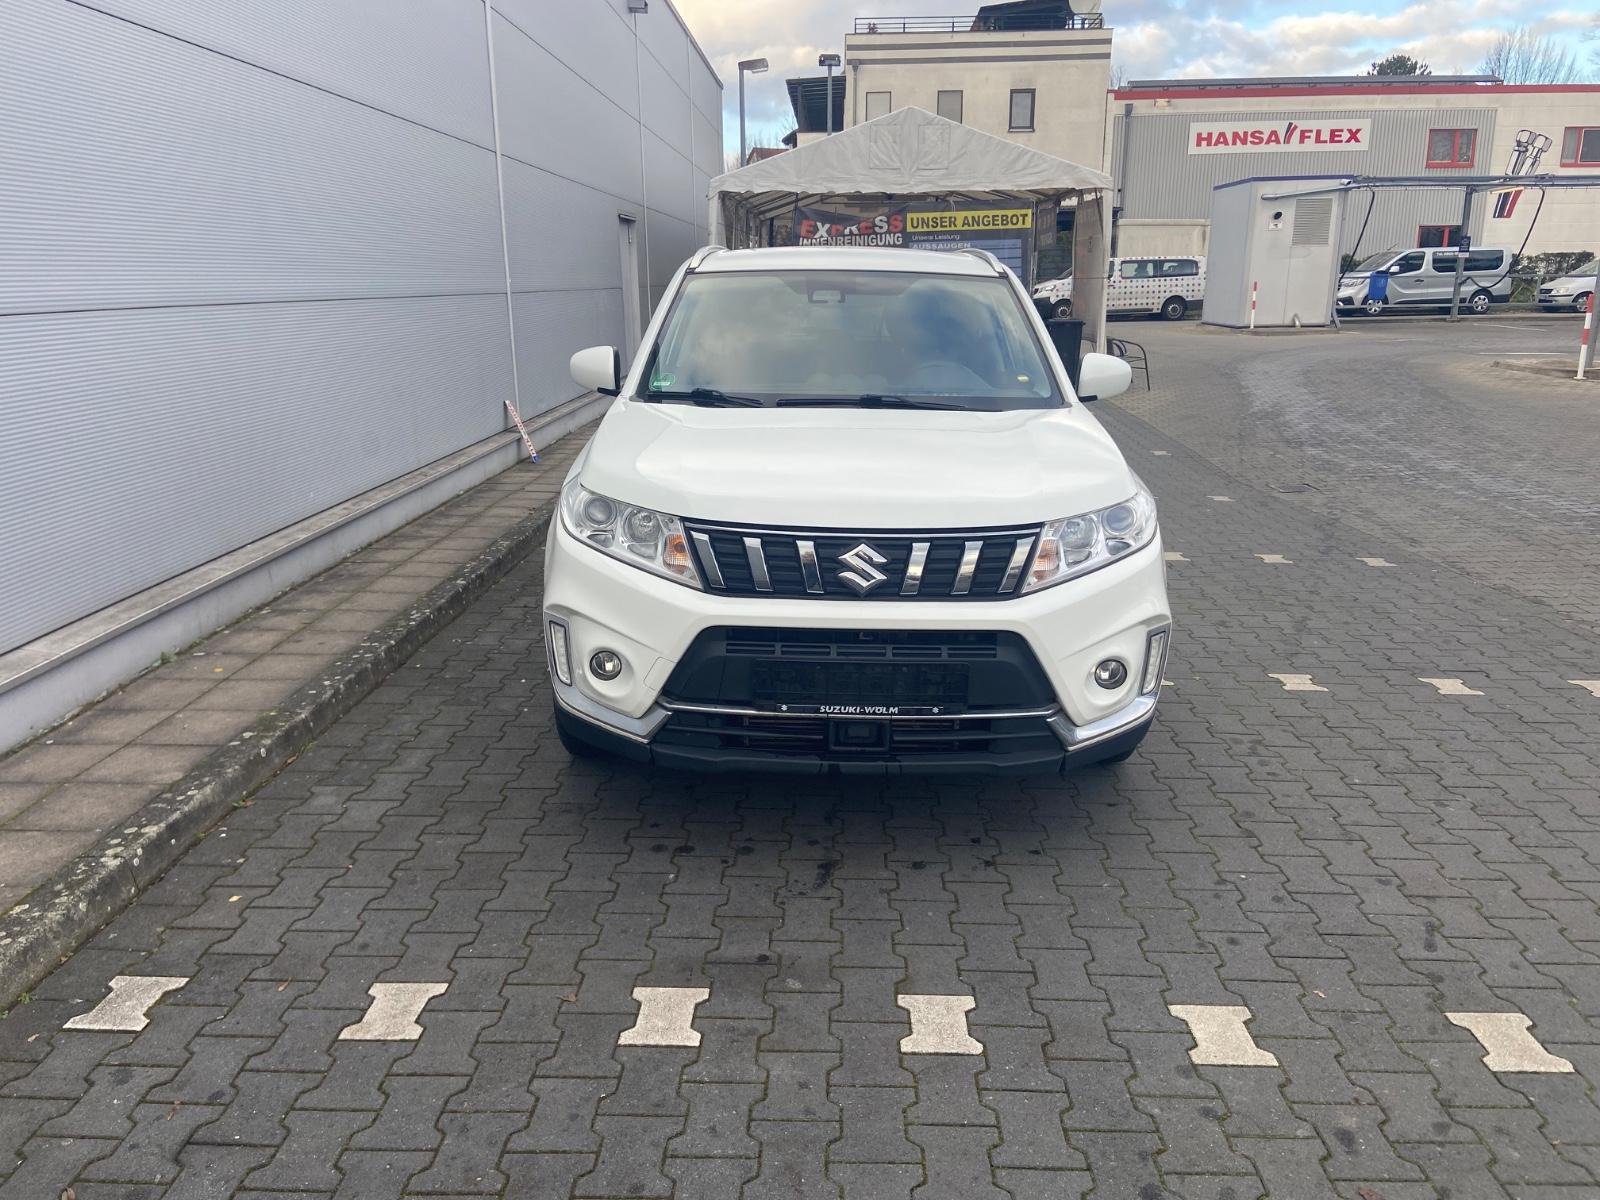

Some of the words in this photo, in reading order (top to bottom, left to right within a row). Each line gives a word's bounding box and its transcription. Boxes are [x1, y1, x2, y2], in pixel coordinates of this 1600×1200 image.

[1195, 130, 1281, 147] HANSA
[1299, 128, 1362, 144] FLEX
[800, 214, 903, 239] EXPRESS
[910, 216, 957, 229] UNSER
[962, 213, 1028, 228] ANGEBOT
[799, 233, 903, 246] INNENREINIGUNG
[912, 242, 972, 250] AUSSAUGEN
